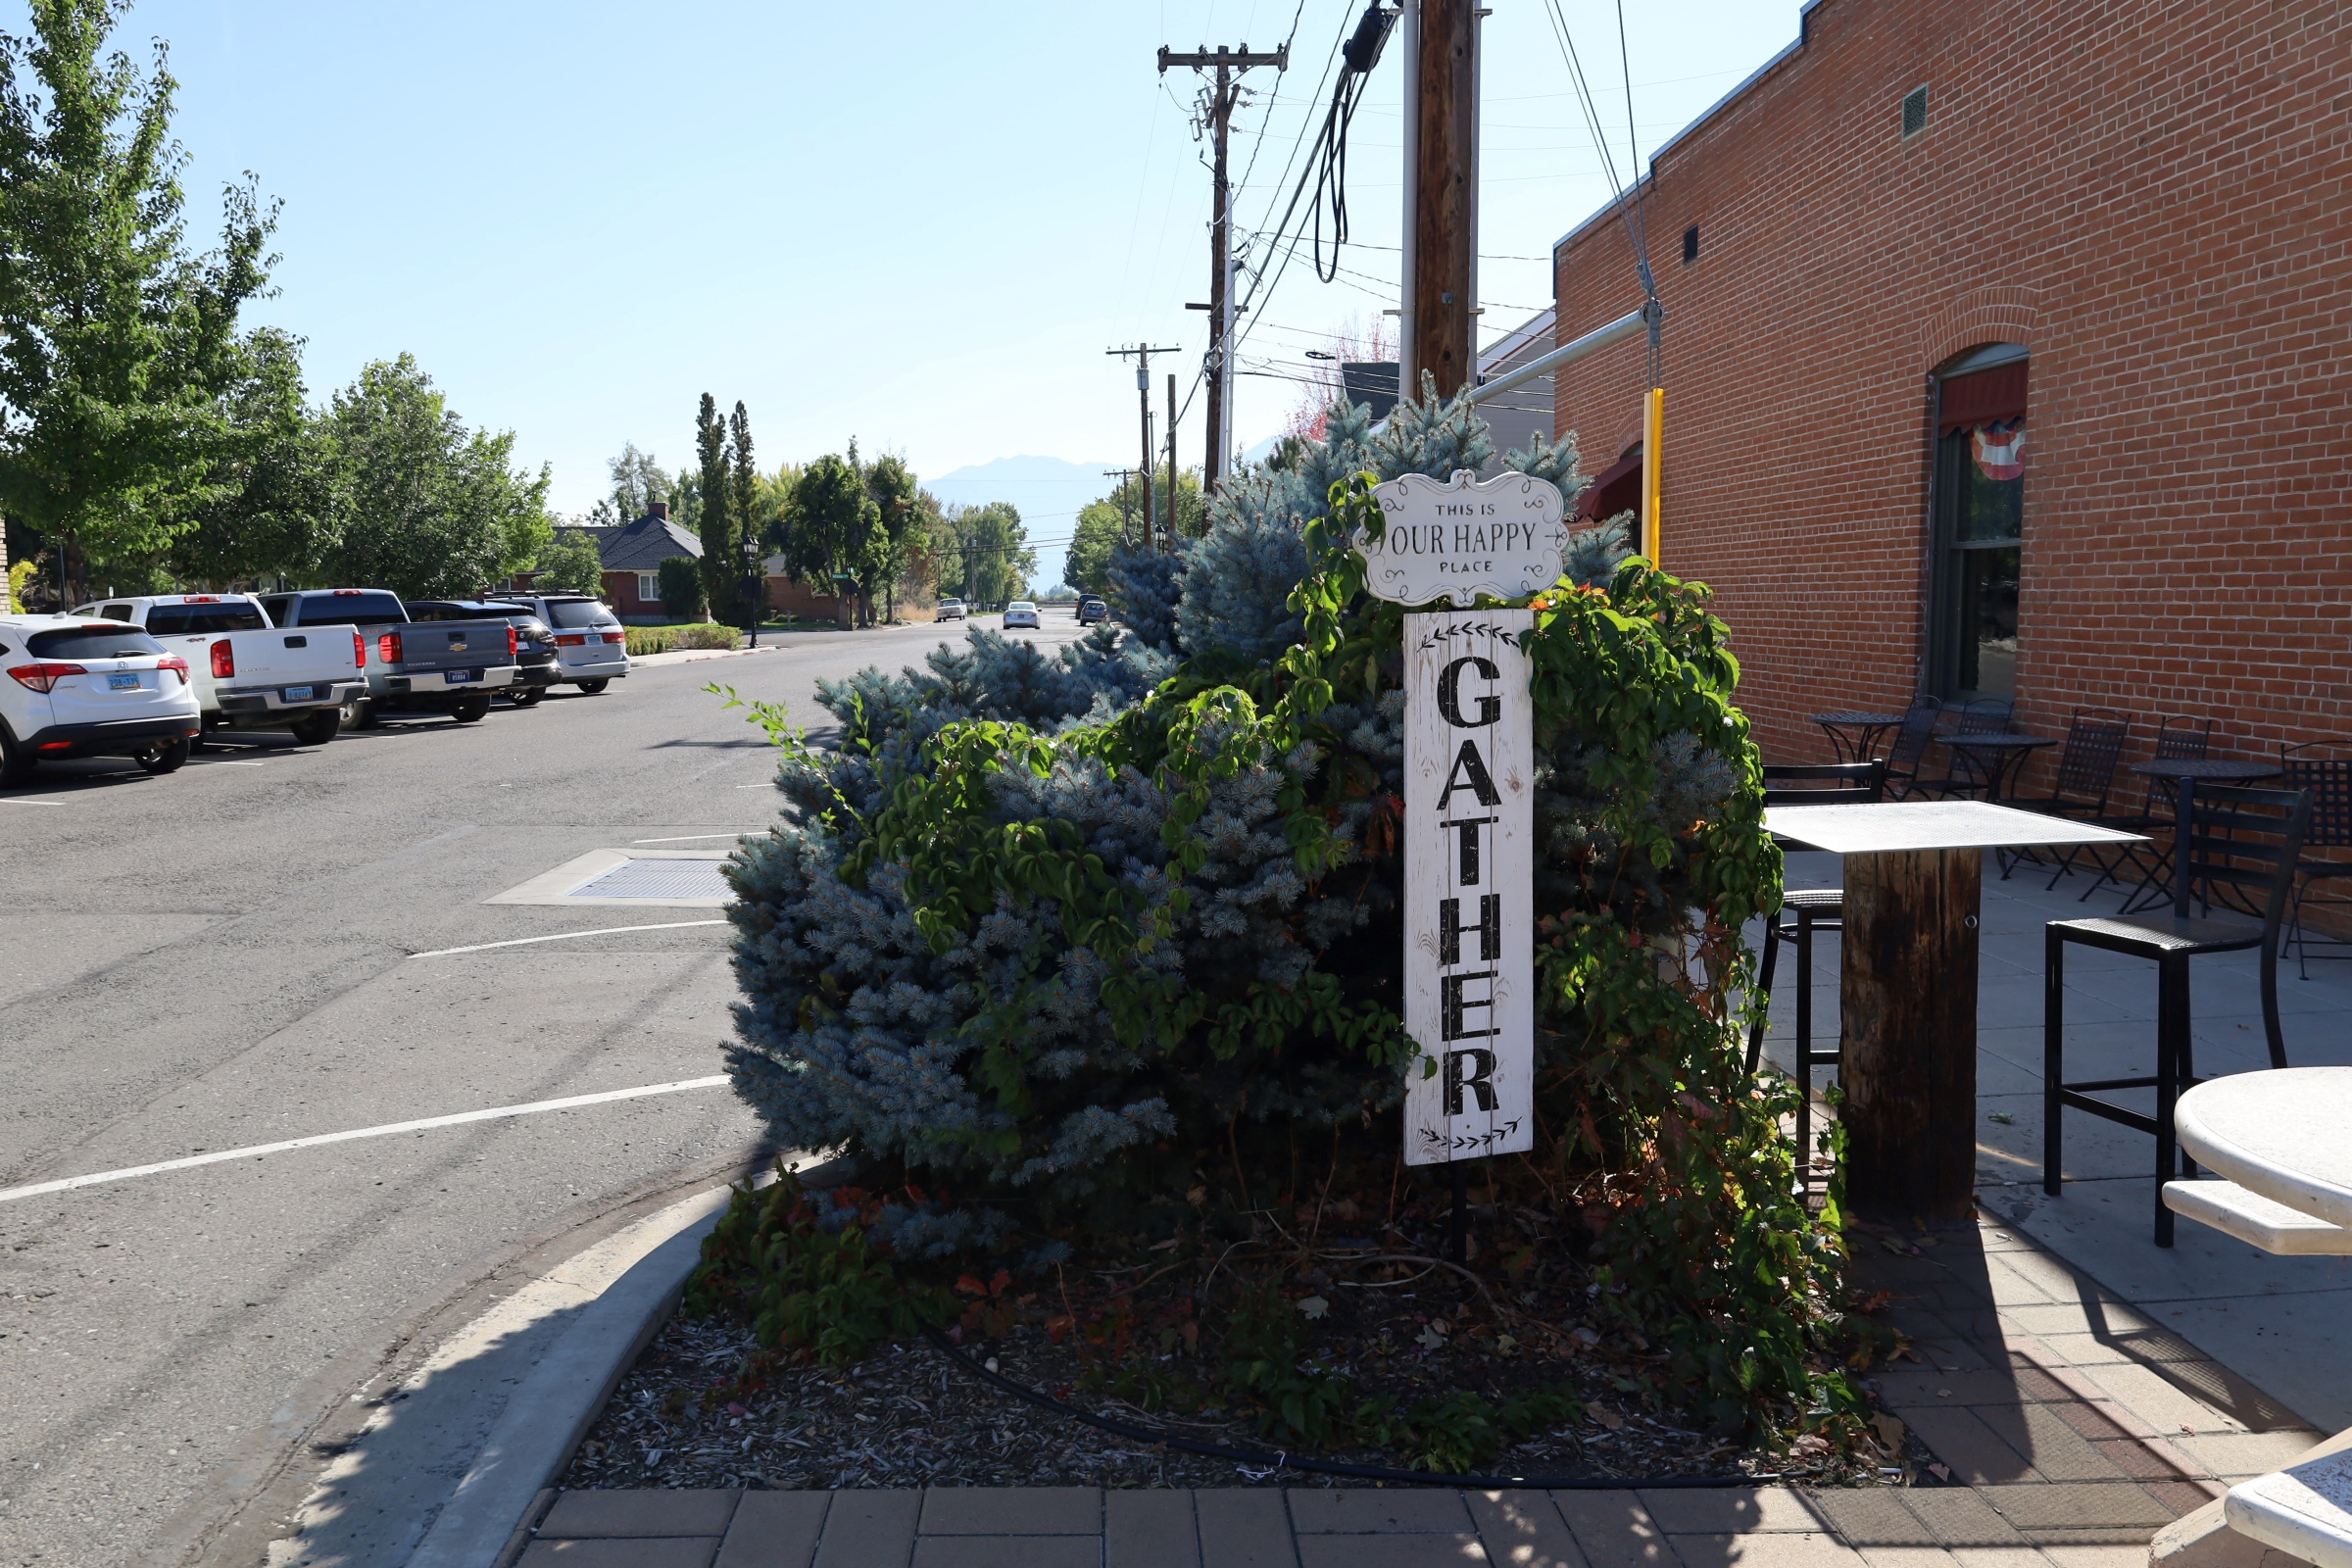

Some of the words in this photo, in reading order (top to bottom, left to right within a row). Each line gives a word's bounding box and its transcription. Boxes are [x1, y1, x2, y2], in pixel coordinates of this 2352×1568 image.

[1435, 504, 1473, 516] THIS
[1481, 504, 1494, 515] IS
[1391, 525, 1445, 555] OUR
[1454, 522, 1537, 554] HAPPY
[1439, 561, 1494, 573] PLACE
[1436, 656, 1502, 1117] GATHER
